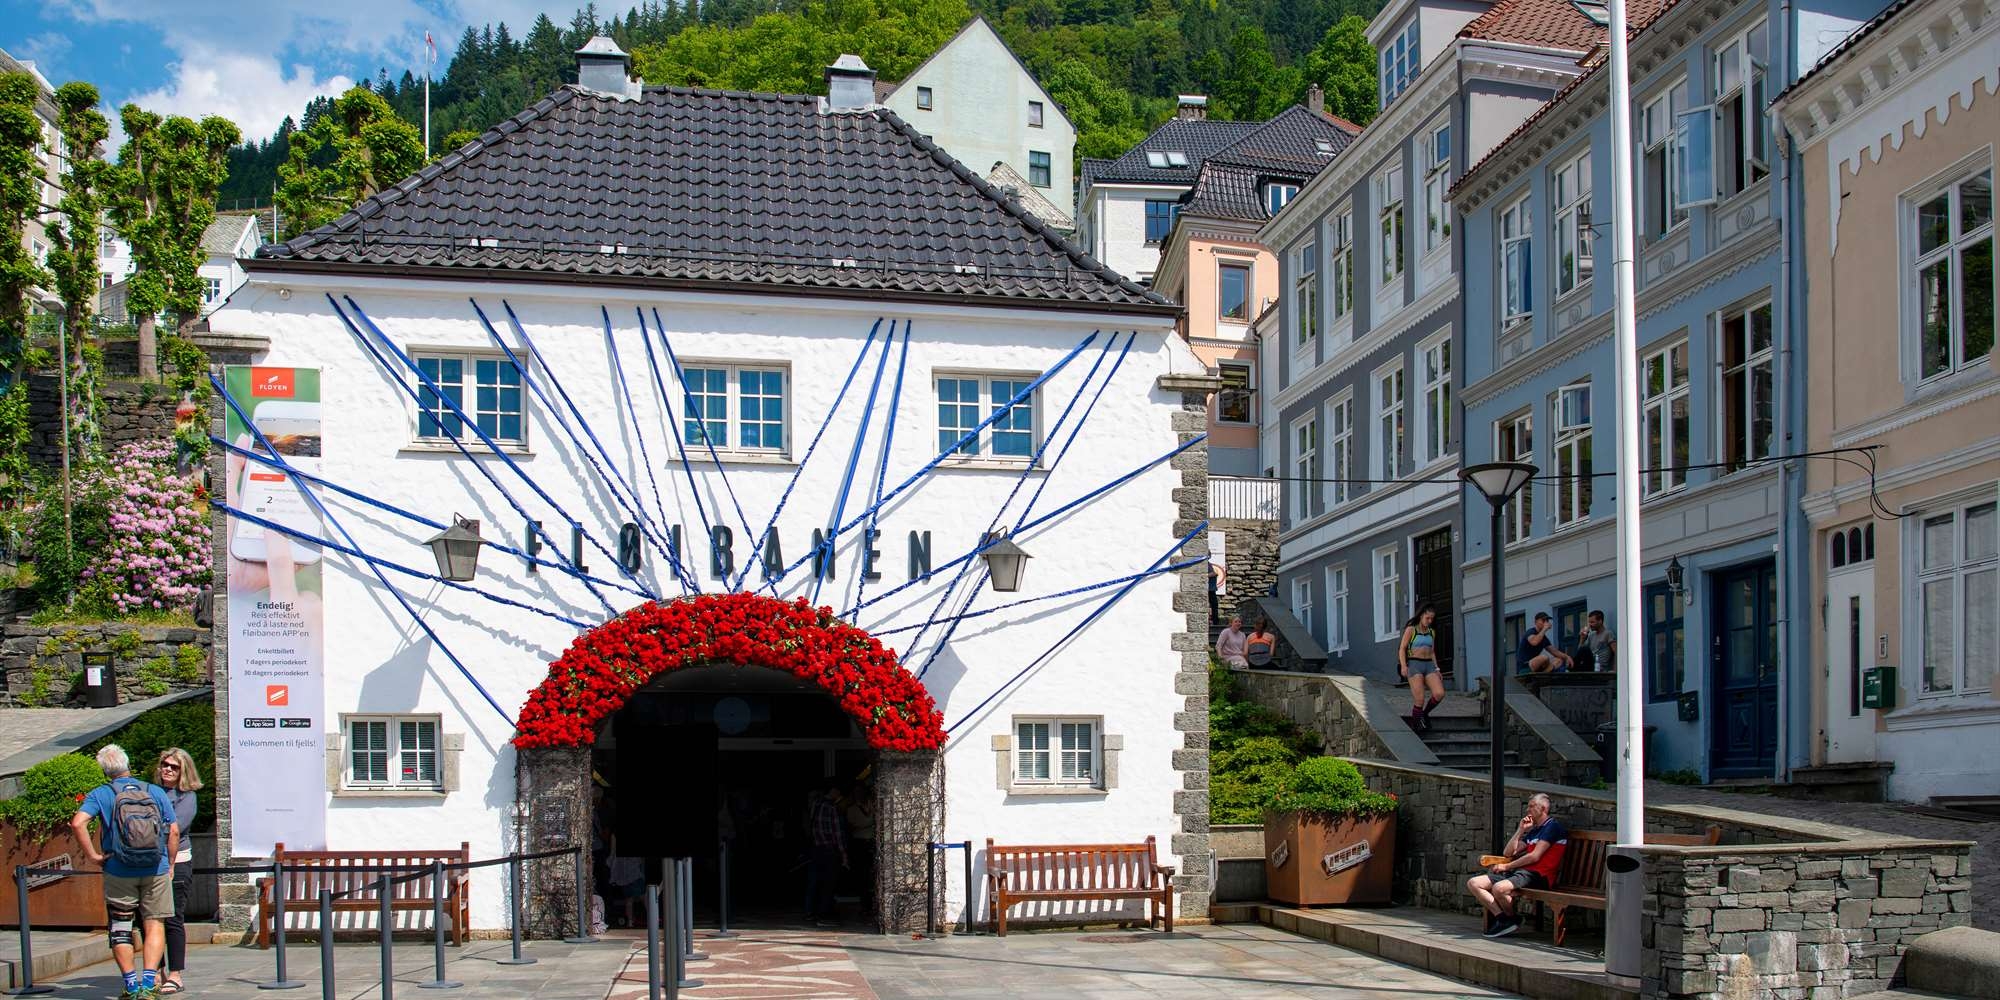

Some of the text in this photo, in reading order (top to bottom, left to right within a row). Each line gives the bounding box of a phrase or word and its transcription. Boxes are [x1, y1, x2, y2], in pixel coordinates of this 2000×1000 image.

[266, 496, 273, 504] 2
[526, 520, 931, 582] FLØIBANEN
[257, 601, 294, 611] Endelig!
[251, 611, 300, 619] Reis effektivt
[242, 629, 281, 637] Fløibanen
[239, 739, 316, 748] Velkommen til fjells!
